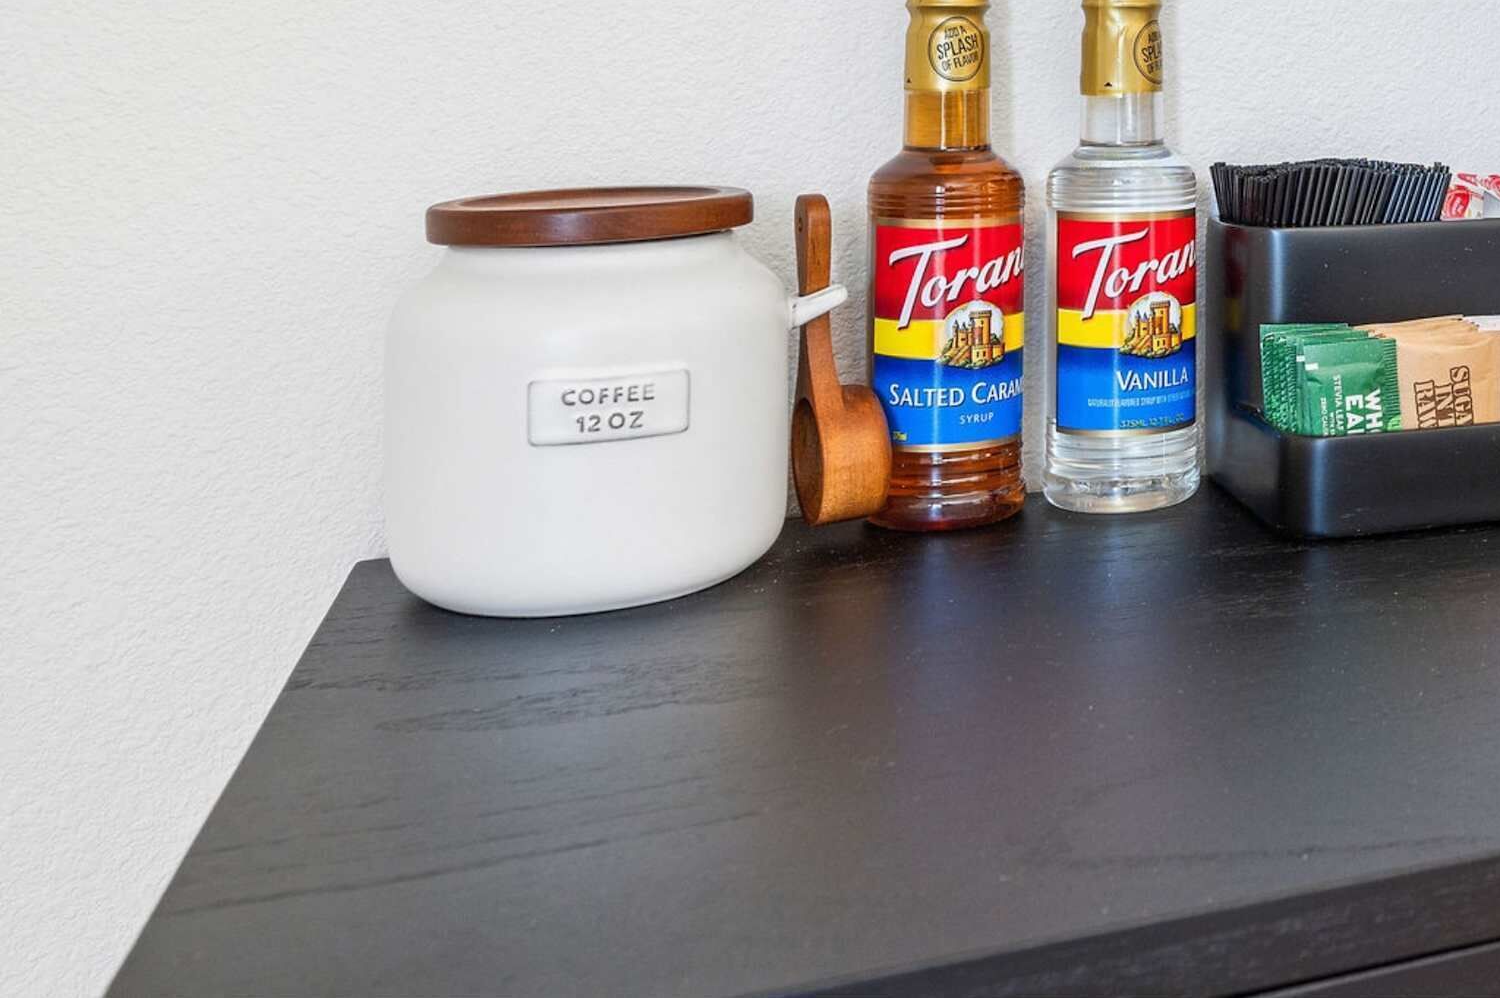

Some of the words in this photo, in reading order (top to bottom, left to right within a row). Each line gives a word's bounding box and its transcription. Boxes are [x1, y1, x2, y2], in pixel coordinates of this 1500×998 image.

[936, 33, 979, 60] SPLASH
[1115, 366, 1189, 392] VANILLA
[1333, 373, 1343, 407] STEVIA
[561, 383, 656, 406] COFFEE
[888, 383, 965, 408] SALTED
[576, 415, 601, 433] 12
[607, 410, 645, 430] OZ
[959, 412, 995, 425] SYRUP
